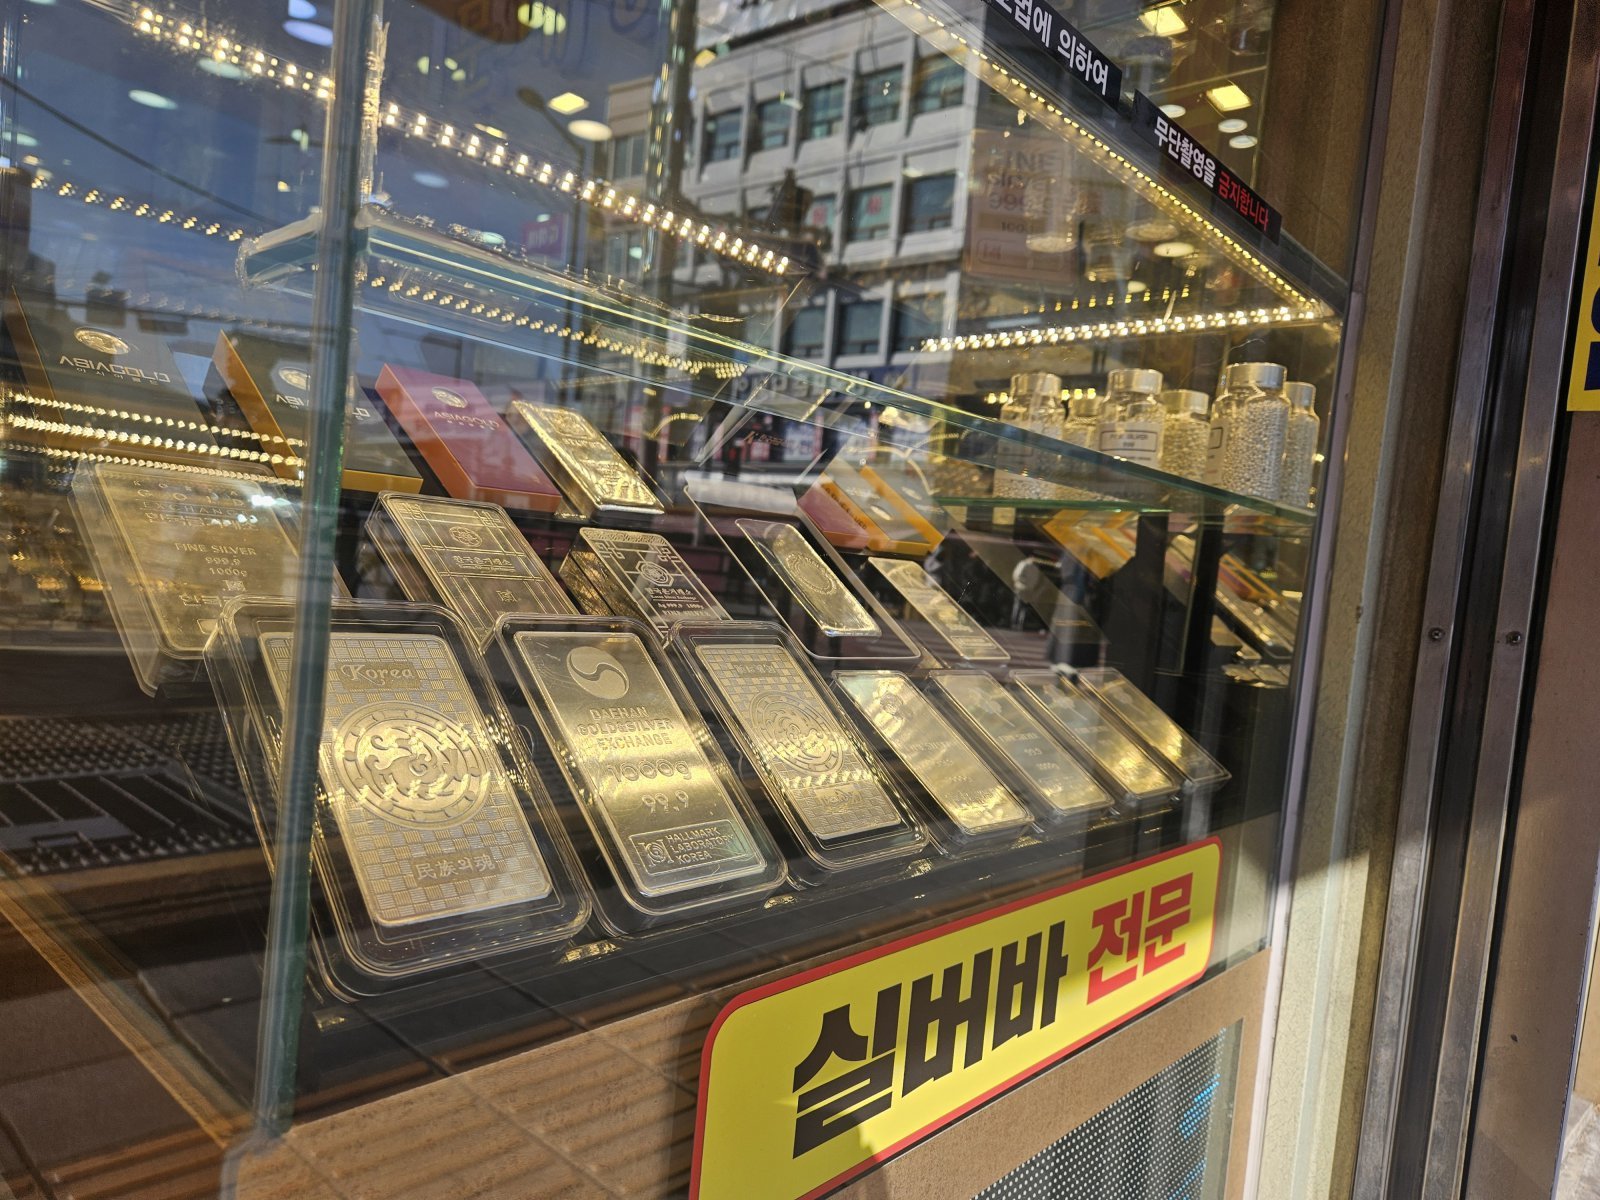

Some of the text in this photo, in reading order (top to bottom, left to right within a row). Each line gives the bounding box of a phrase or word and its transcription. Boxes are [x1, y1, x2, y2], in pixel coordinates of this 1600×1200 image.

[995, 0, 1108, 95] 법에 의하여
[1154, 116, 1269, 231] 무단촬영을 금지합니다
[60, 355, 171, 383] ASIAGOLD
[434, 411, 499, 428] ASIAGOLD
[175, 543, 257, 556] FINE SILVER
[209, 567, 248, 577] 1000g
[340, 664, 416, 686] Korea
[590, 706, 650, 720] DAEHAN
[577, 718, 675, 736] GOLD&SILVER
[598, 733, 673, 750] EXCHANGE
[606, 759, 692, 783] 1000g
[641, 790, 689, 814] 99.9
[665, 827, 720, 843] HALLMARK
[670, 834, 734, 853] LABORATORY
[676, 850, 712, 864] KOREA
[792, 872, 1194, 1159] 실버바 전문
